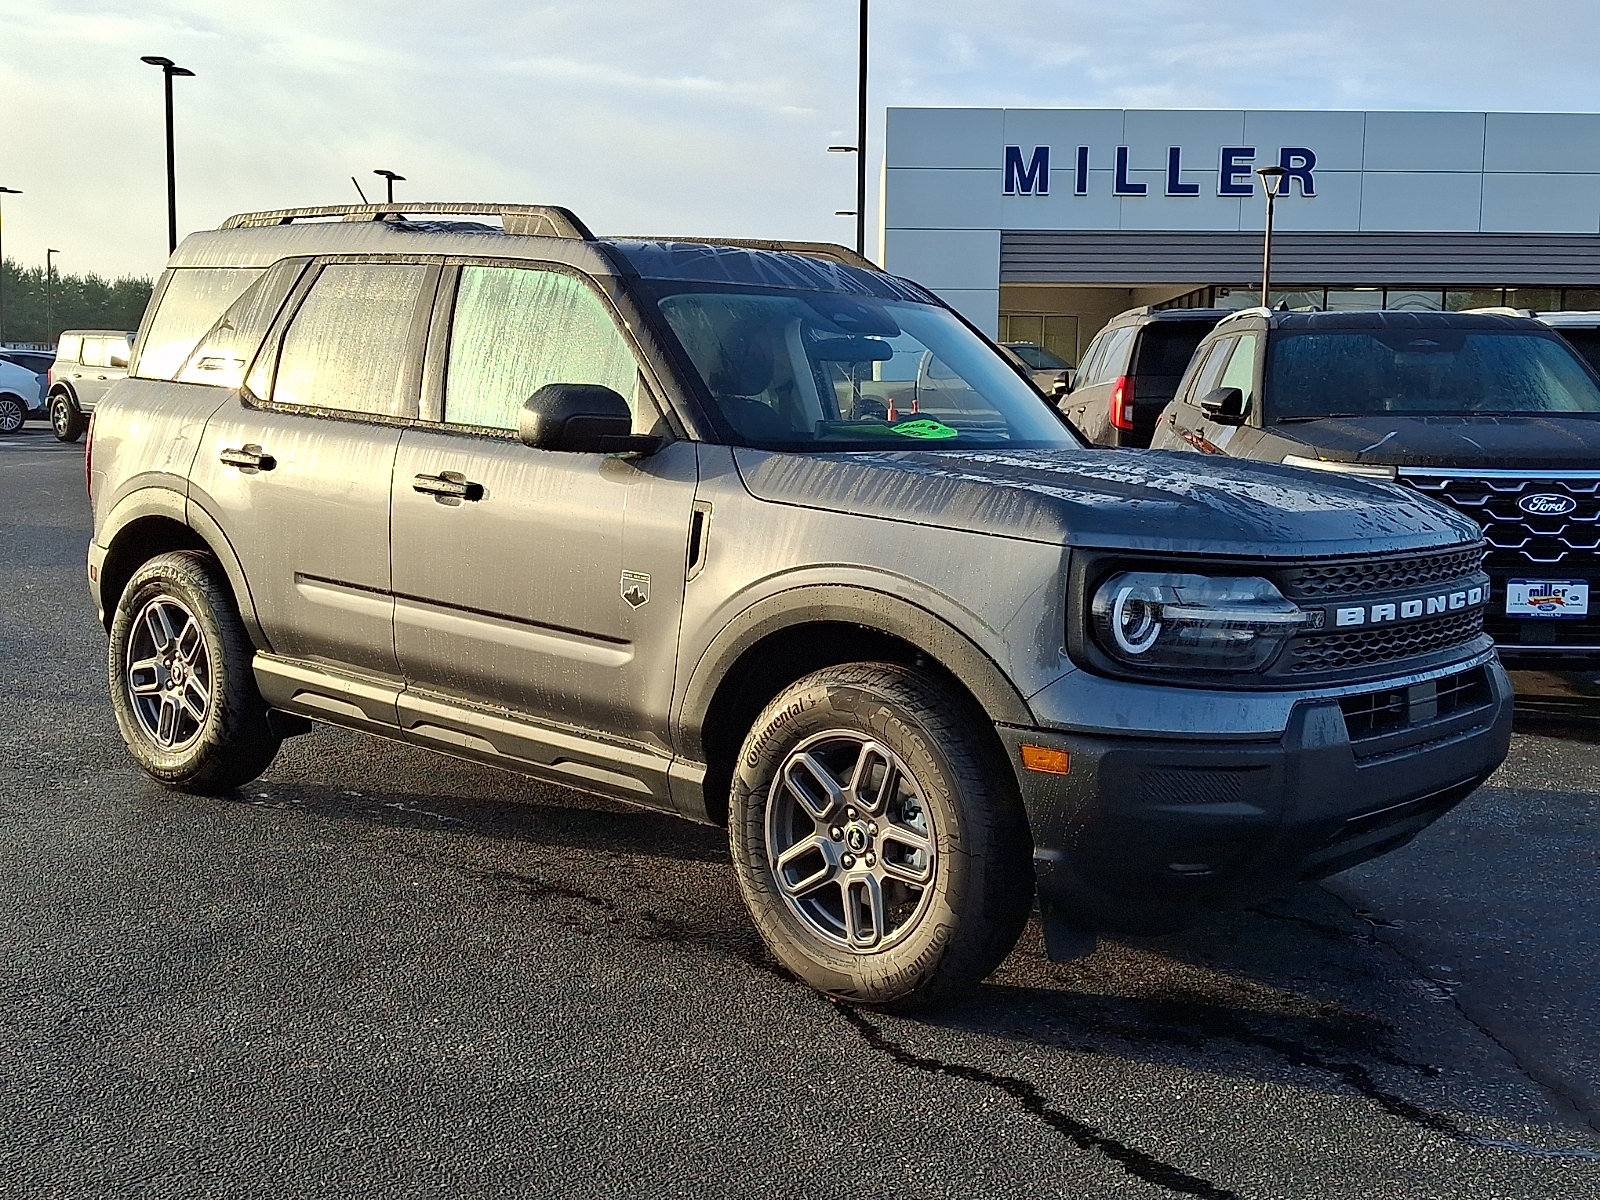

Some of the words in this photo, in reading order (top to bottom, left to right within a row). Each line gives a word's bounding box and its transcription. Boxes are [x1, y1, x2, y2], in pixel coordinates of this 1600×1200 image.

[1002, 145, 1318, 197] MILLER
[1528, 494, 1567, 512] Ford
[1336, 587, 1482, 627] BRONCO
[1528, 584, 1568, 597] miller
[746, 697, 805, 768] Continental
